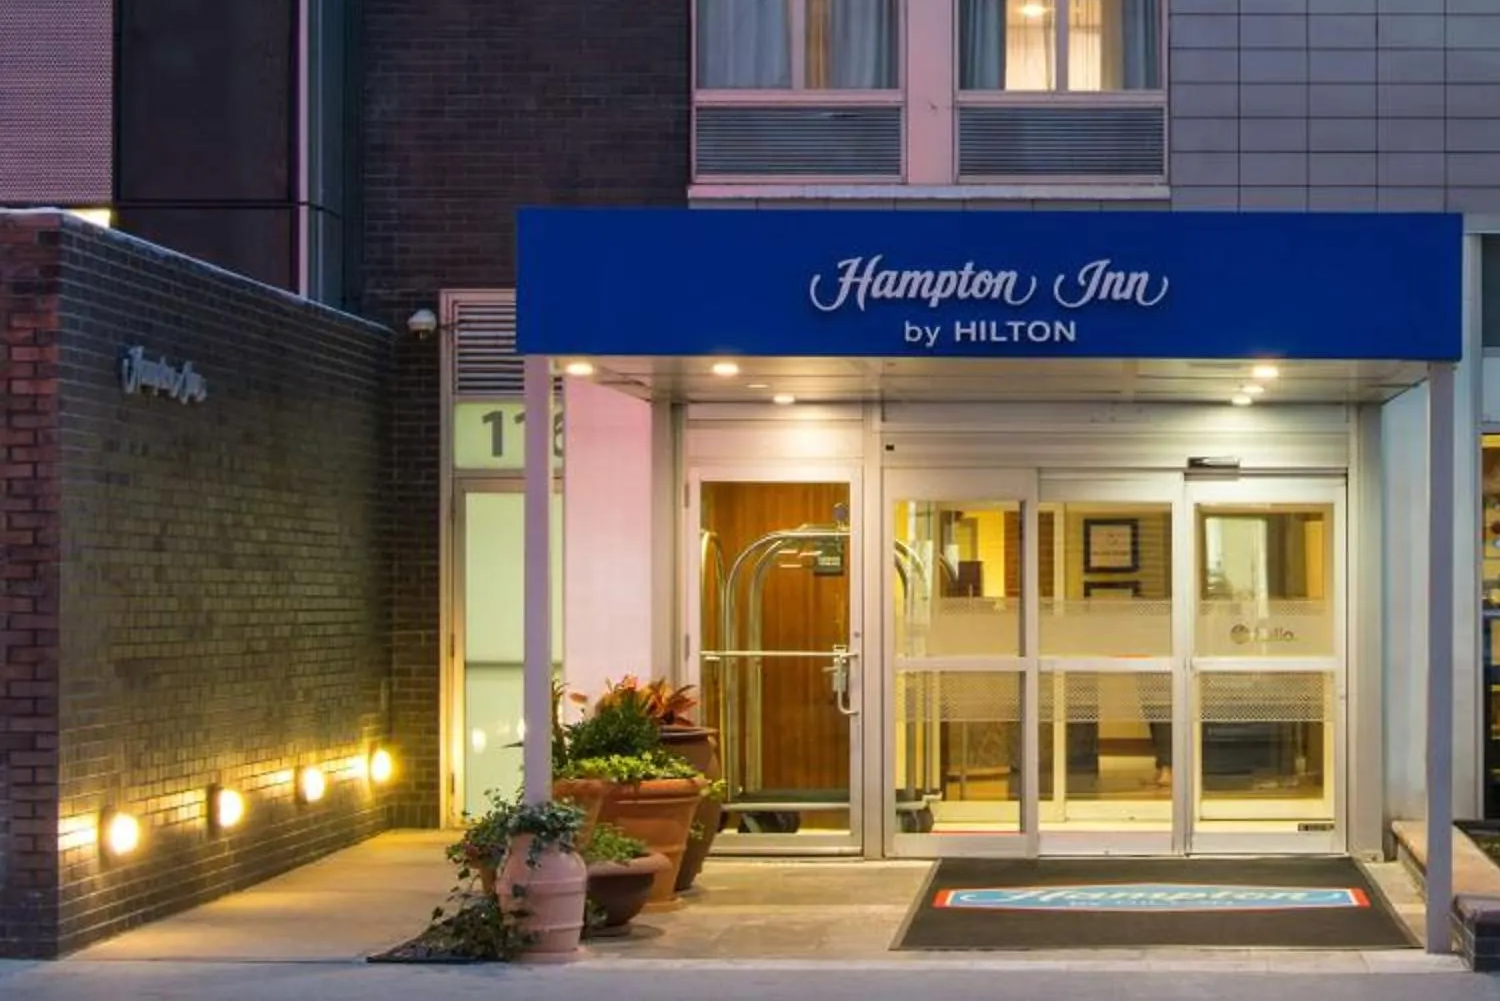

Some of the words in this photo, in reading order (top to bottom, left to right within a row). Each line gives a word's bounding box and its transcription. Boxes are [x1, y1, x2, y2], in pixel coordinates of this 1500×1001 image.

[810, 254, 1037, 311] Hampton
[1053, 258, 1169, 308] Inn
[904, 321, 941, 347] by
[954, 320, 1077, 343] HILTON
